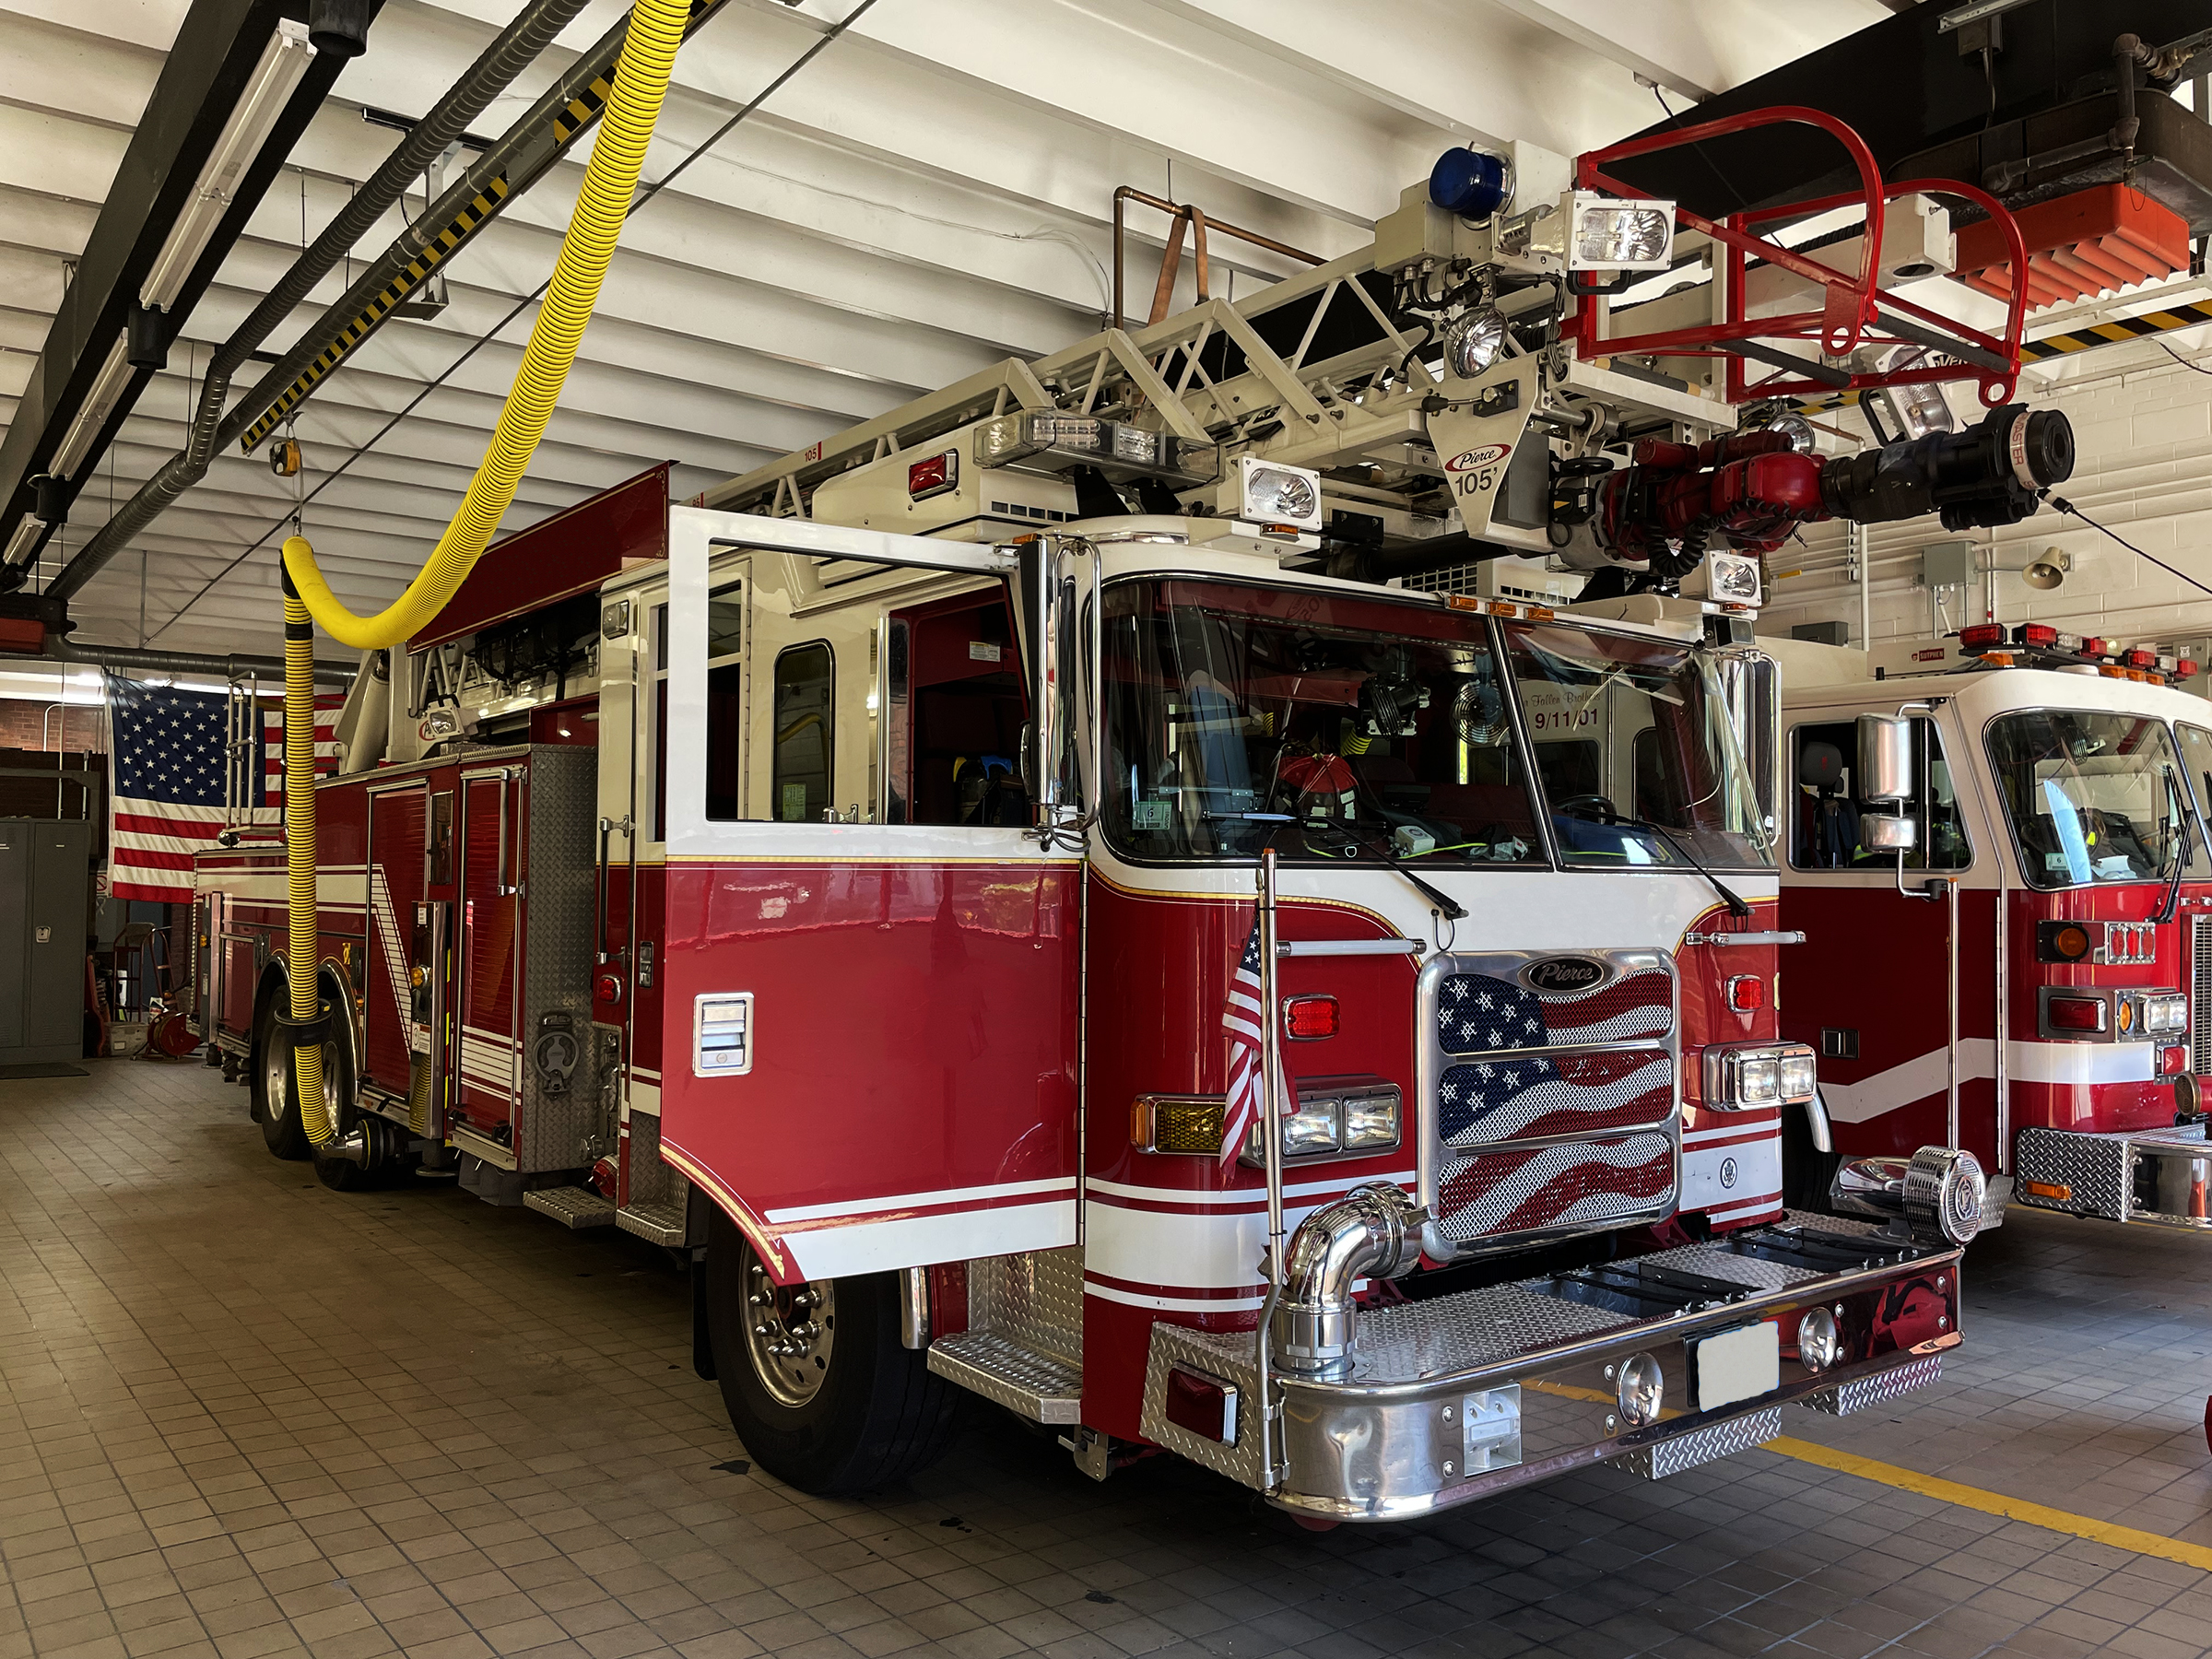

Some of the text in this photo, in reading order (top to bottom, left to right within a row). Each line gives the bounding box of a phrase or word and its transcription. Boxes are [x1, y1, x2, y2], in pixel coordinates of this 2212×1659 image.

[805, 448, 817, 462] 105
[1459, 449, 1496, 468] Pierce
[1454, 466, 1498, 497] 105'
[1920, 650, 1944, 660] SUTPHEN
[1535, 708, 1598, 731] 9/11/01
[1147, 807, 1154, 818] 6
[1537, 962, 1594, 985] Pierce
